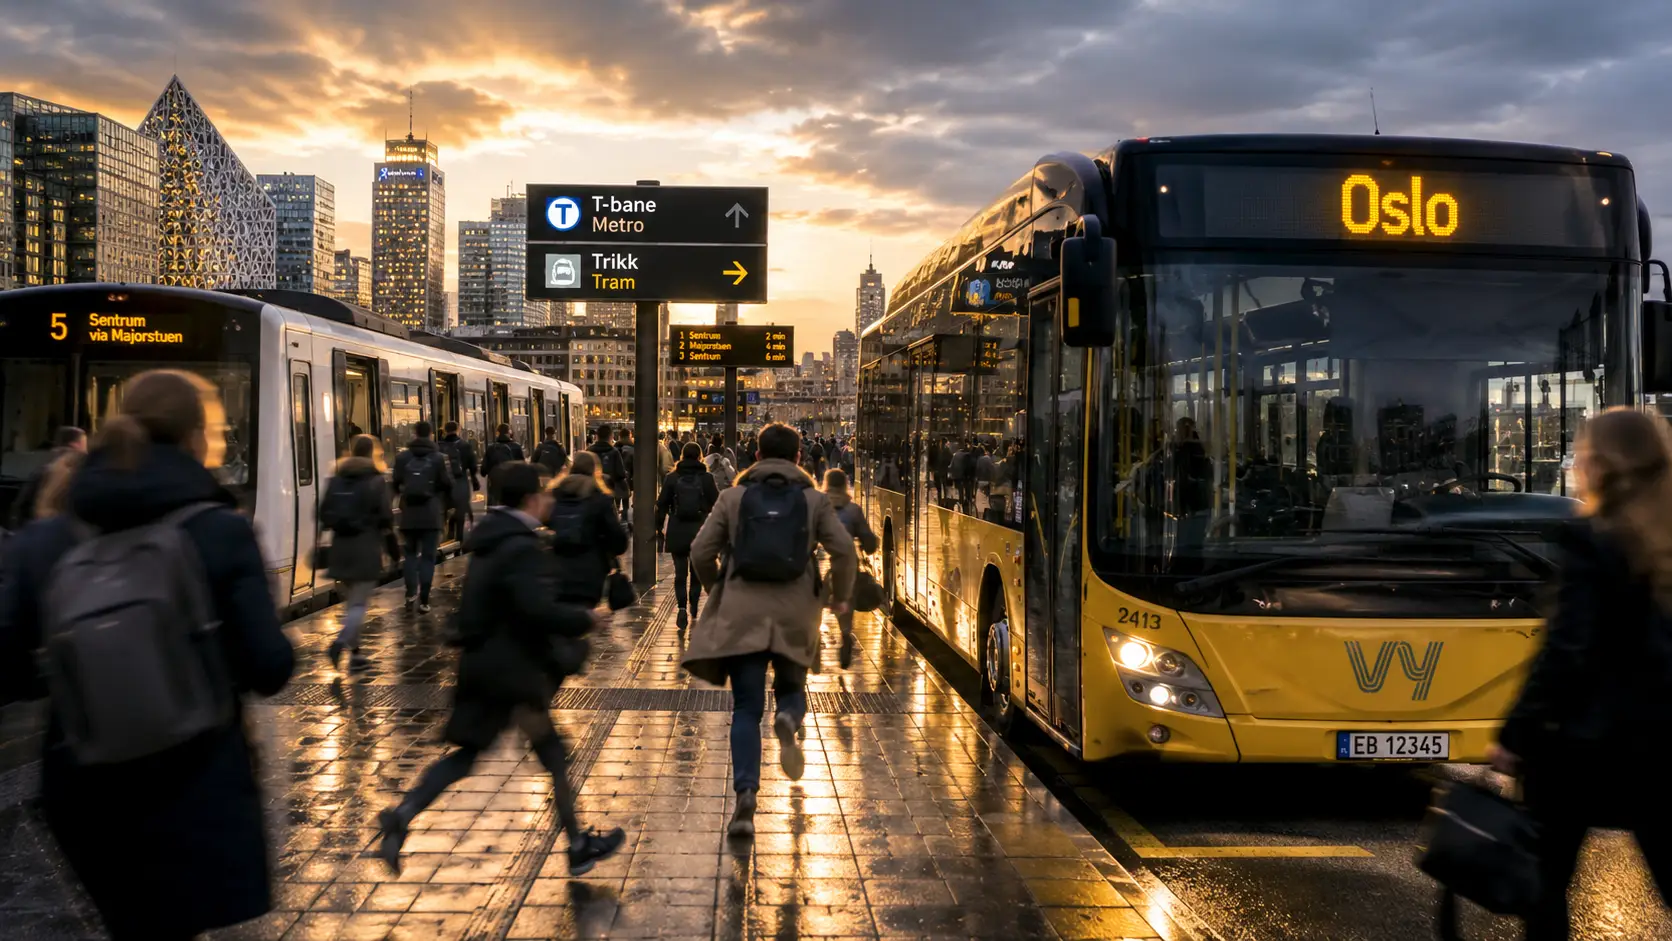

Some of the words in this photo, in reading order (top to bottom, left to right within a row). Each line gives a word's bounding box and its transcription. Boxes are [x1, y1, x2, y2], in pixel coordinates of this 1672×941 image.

[591, 195, 657, 213] T-bane
[1341, 174, 1459, 237] Oslo
[554, 203, 573, 225] T
[591, 216, 645, 233] Metro
[591, 252, 639, 270] Trikk
[591, 273, 636, 290] Tram
[50, 312, 68, 341] 5
[88, 312, 147, 328] Sentrum
[88, 328, 109, 342] via
[110, 328, 183, 345] Majorstuen
[679, 331, 685, 340] 1
[765, 332, 771, 341] 2
[679, 341, 685, 350] 2
[1118, 606, 1162, 630] 2413
[1353, 735, 1378, 755] EB
[1385, 735, 1442, 755] 12345
